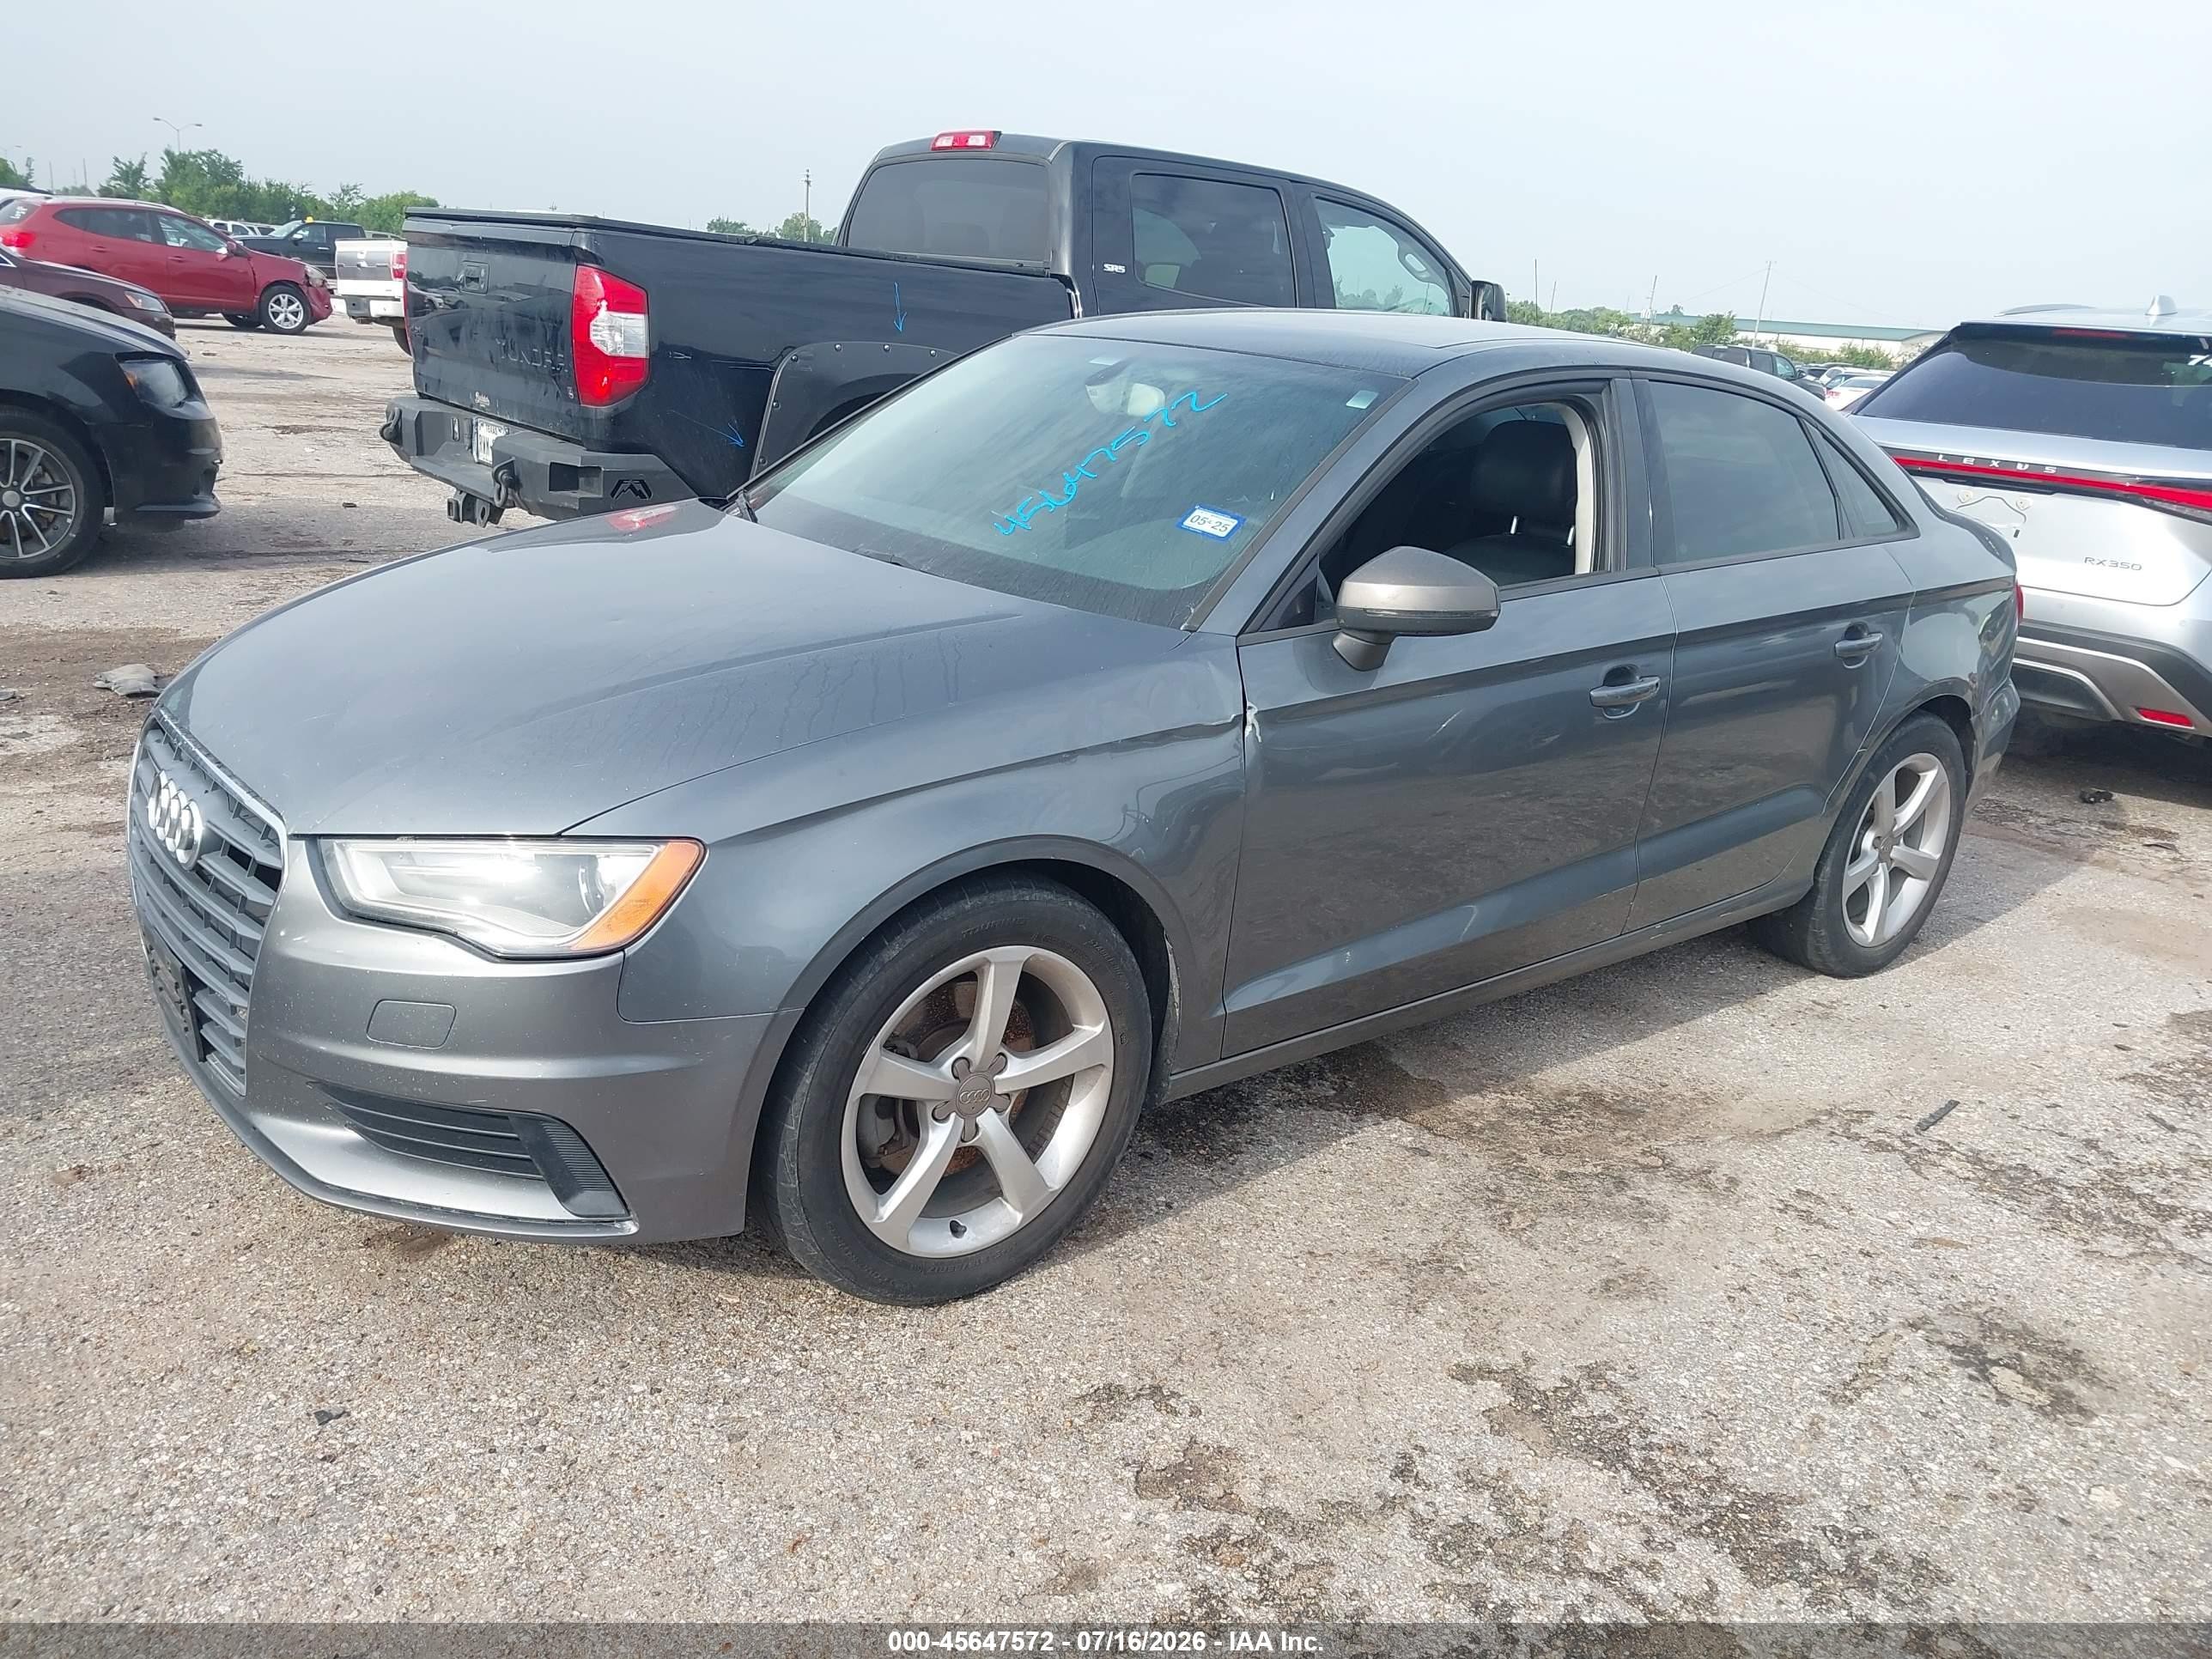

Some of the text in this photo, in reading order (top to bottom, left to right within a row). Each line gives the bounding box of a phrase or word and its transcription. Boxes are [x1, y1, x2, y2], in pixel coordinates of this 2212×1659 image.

[1103, 263, 1126, 273] SR5
[495, 337, 570, 373] TUNDRA
[994, 391, 1229, 536] 45647572
[1937, 453, 2057, 474] LEXUS
[1190, 514, 1209, 526] 05
[1211, 520, 1231, 532] 25
[2084, 556, 2142, 571] RX350
